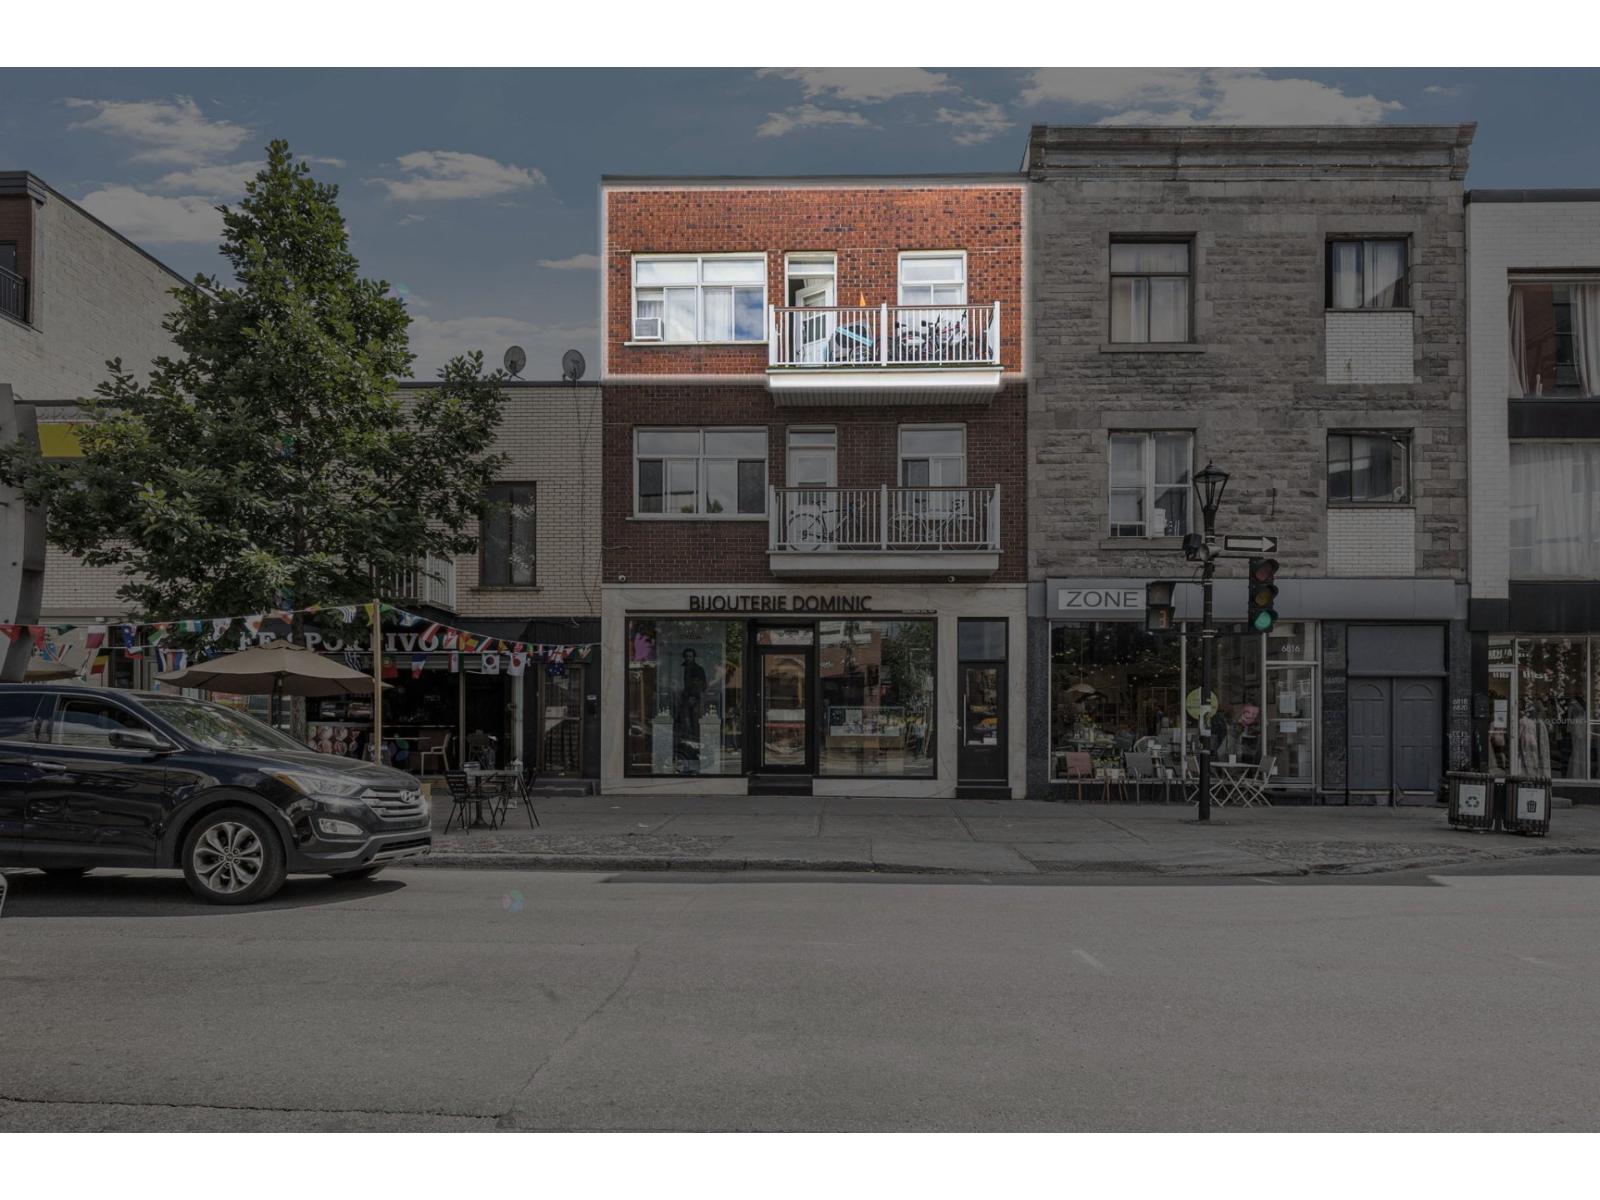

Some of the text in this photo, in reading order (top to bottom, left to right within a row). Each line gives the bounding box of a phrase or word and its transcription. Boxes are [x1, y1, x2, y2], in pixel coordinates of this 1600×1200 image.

[689, 595, 872, 611] BIJOUTERIE DOMINIC
[1066, 591, 1139, 608] ZONE
[1281, 643, 1301, 653] 6816
